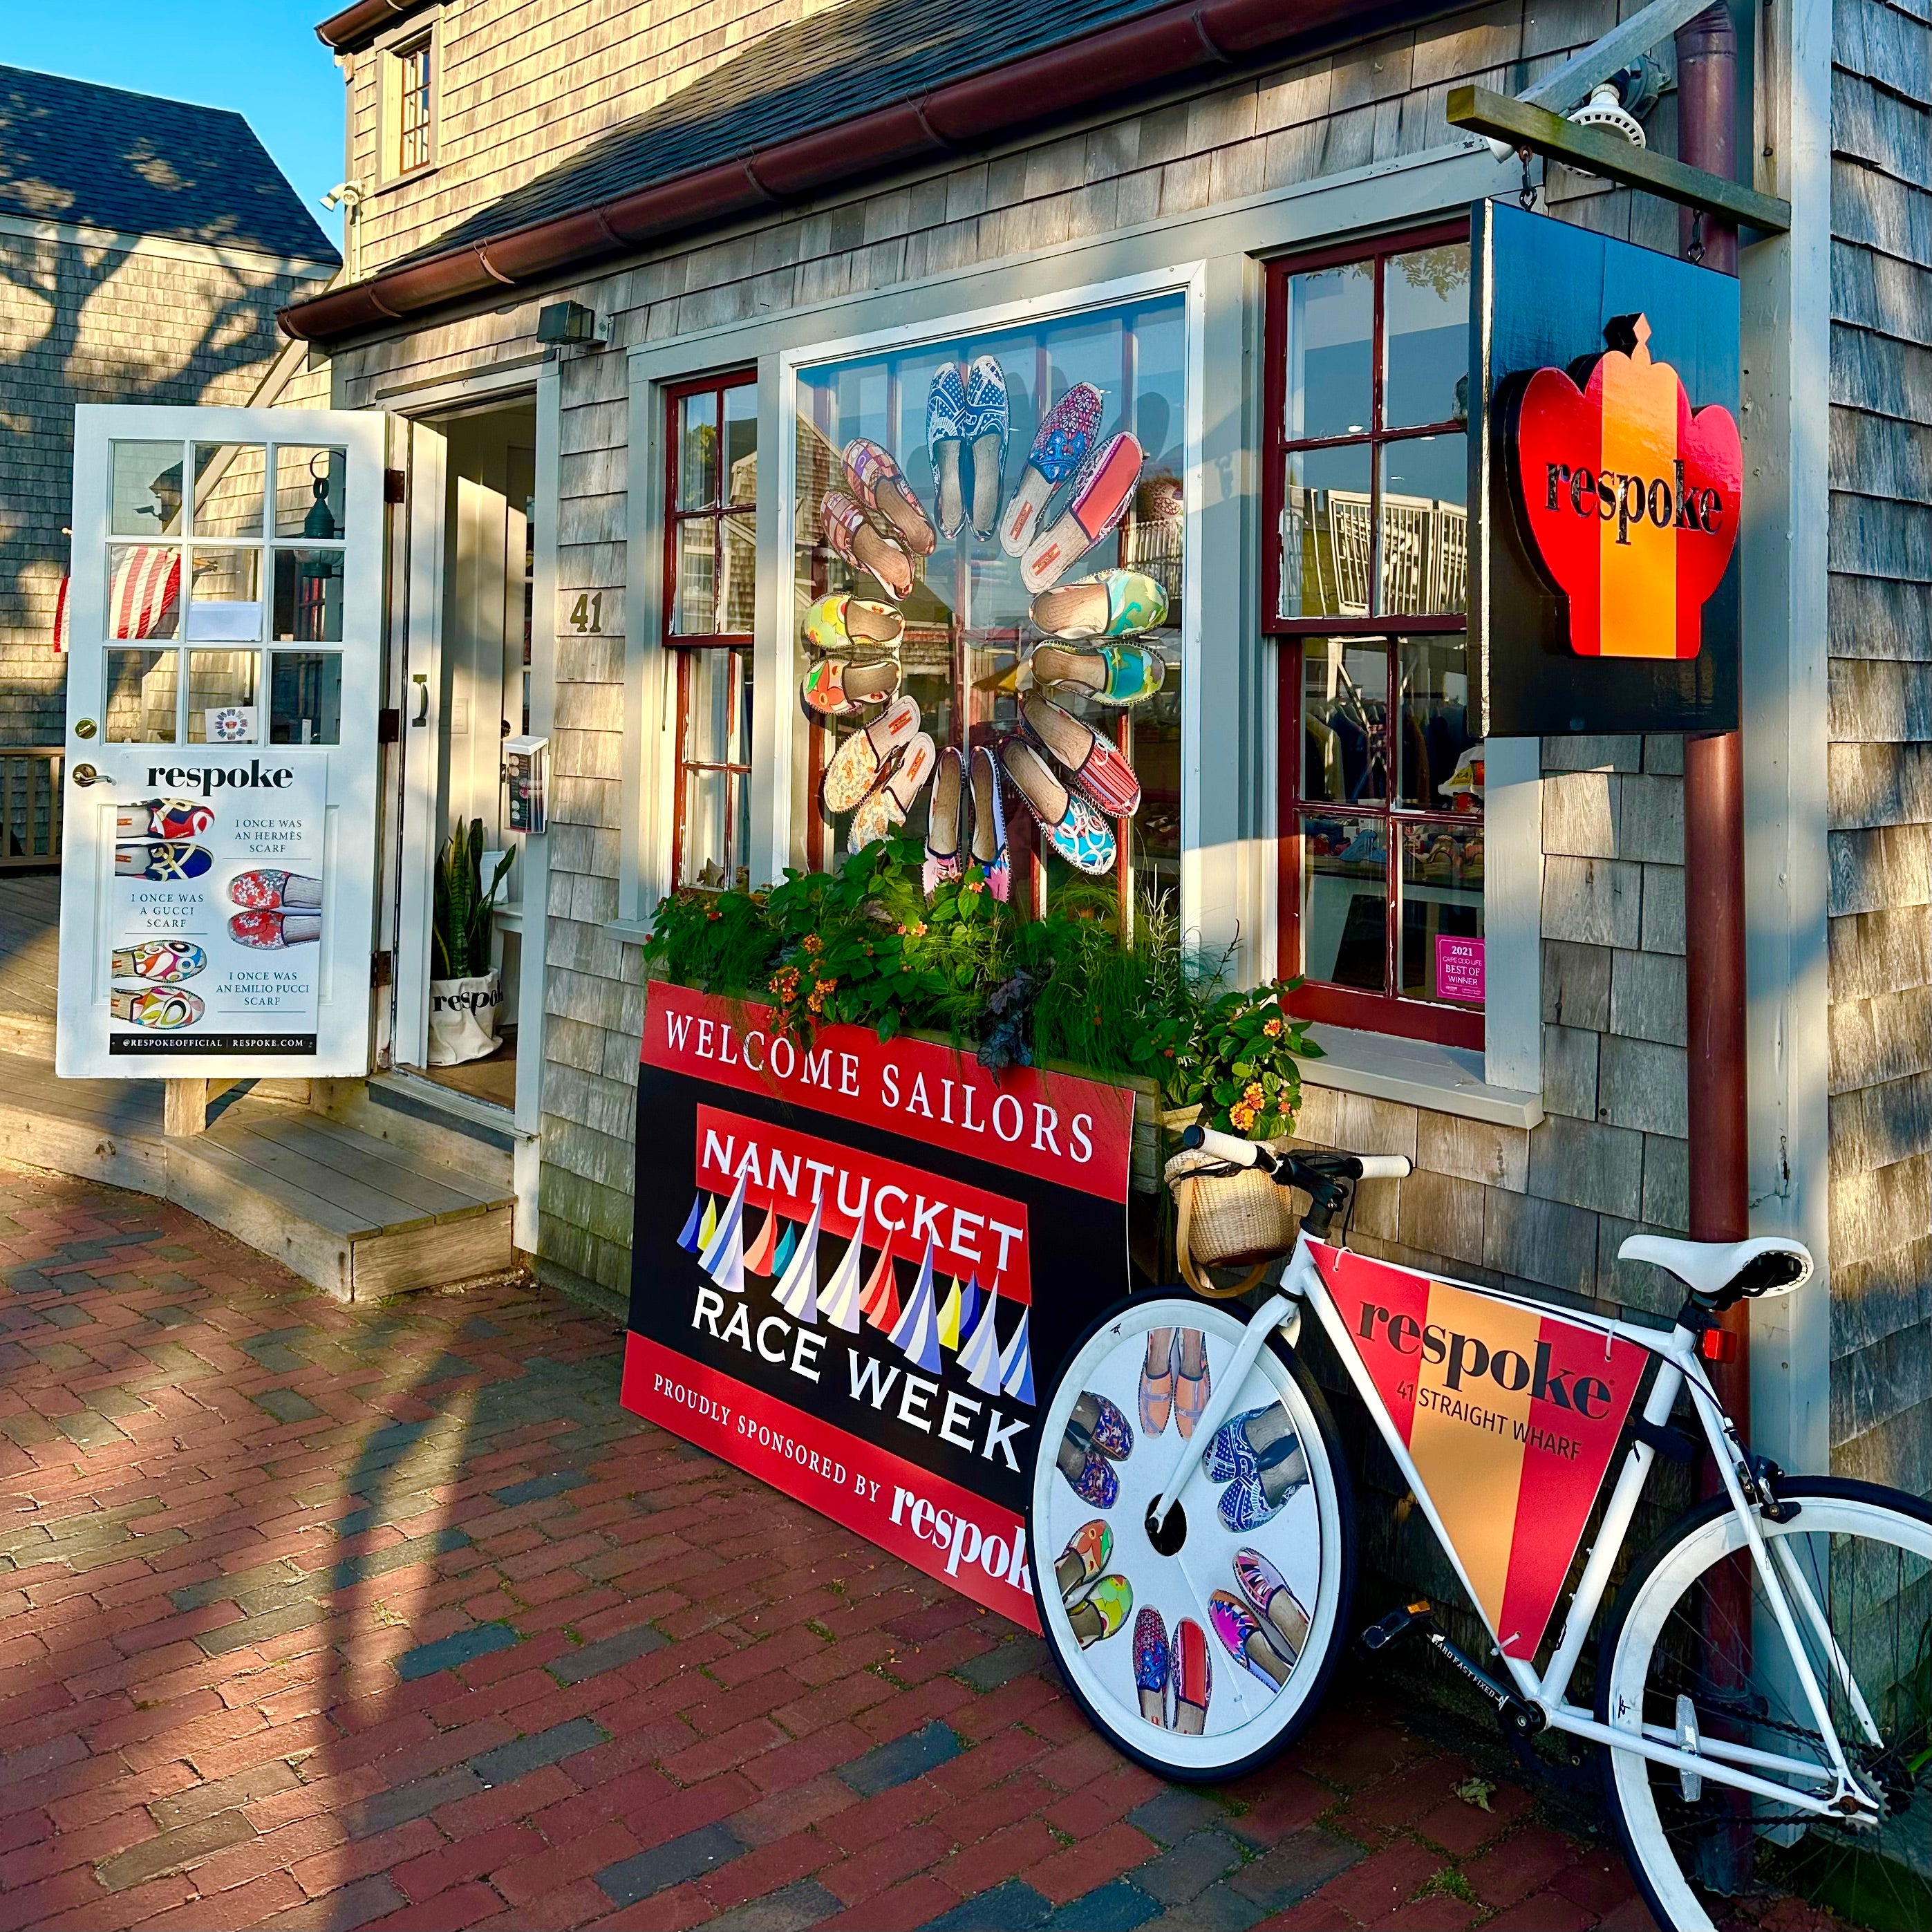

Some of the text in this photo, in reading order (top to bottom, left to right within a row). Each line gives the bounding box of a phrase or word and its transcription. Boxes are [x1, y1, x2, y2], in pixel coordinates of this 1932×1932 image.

[1544, 459, 1723, 546] respoke
[570, 591, 602, 632] 41
[146, 759, 293, 796] respoke
[235, 819, 302, 828] I ONCE WAS
[234, 830, 302, 841] AN HERMÈS
[249, 844, 285, 853] SCARF
[131, 894, 204, 903] I ONCE WAS
[139, 906, 194, 915] A GUCCI
[147, 919, 187, 928] SCARF
[1452, 946, 1473, 956] 2021
[1445, 964, 1481, 976] BEST OF
[229, 972, 297, 980] I ONCE WAS
[1447, 975, 1478, 985] WINNER
[216, 984, 310, 993] AN EMILIO PUCCI
[244, 997, 281, 1006] SCARF
[432, 979, 504, 1016] respok
[123, 1039, 303, 1047] @RESPOKEOFFICIAL RESPOKE.COM
[664, 1009, 1094, 1163] WELCOME SAILORS
[702, 1128, 1024, 1273] NANTUCKET
[1356, 1300, 1612, 1420] respoke
[691, 1285, 1031, 1474] RACE WEEK
[1396, 1380, 1583, 1461] 41 STRAIGHT WHARF
[653, 1373, 1035, 1595] PROUDLY SPONSORED BY respok
[1433, 1639, 1495, 1698] ARD FAST FIXED
